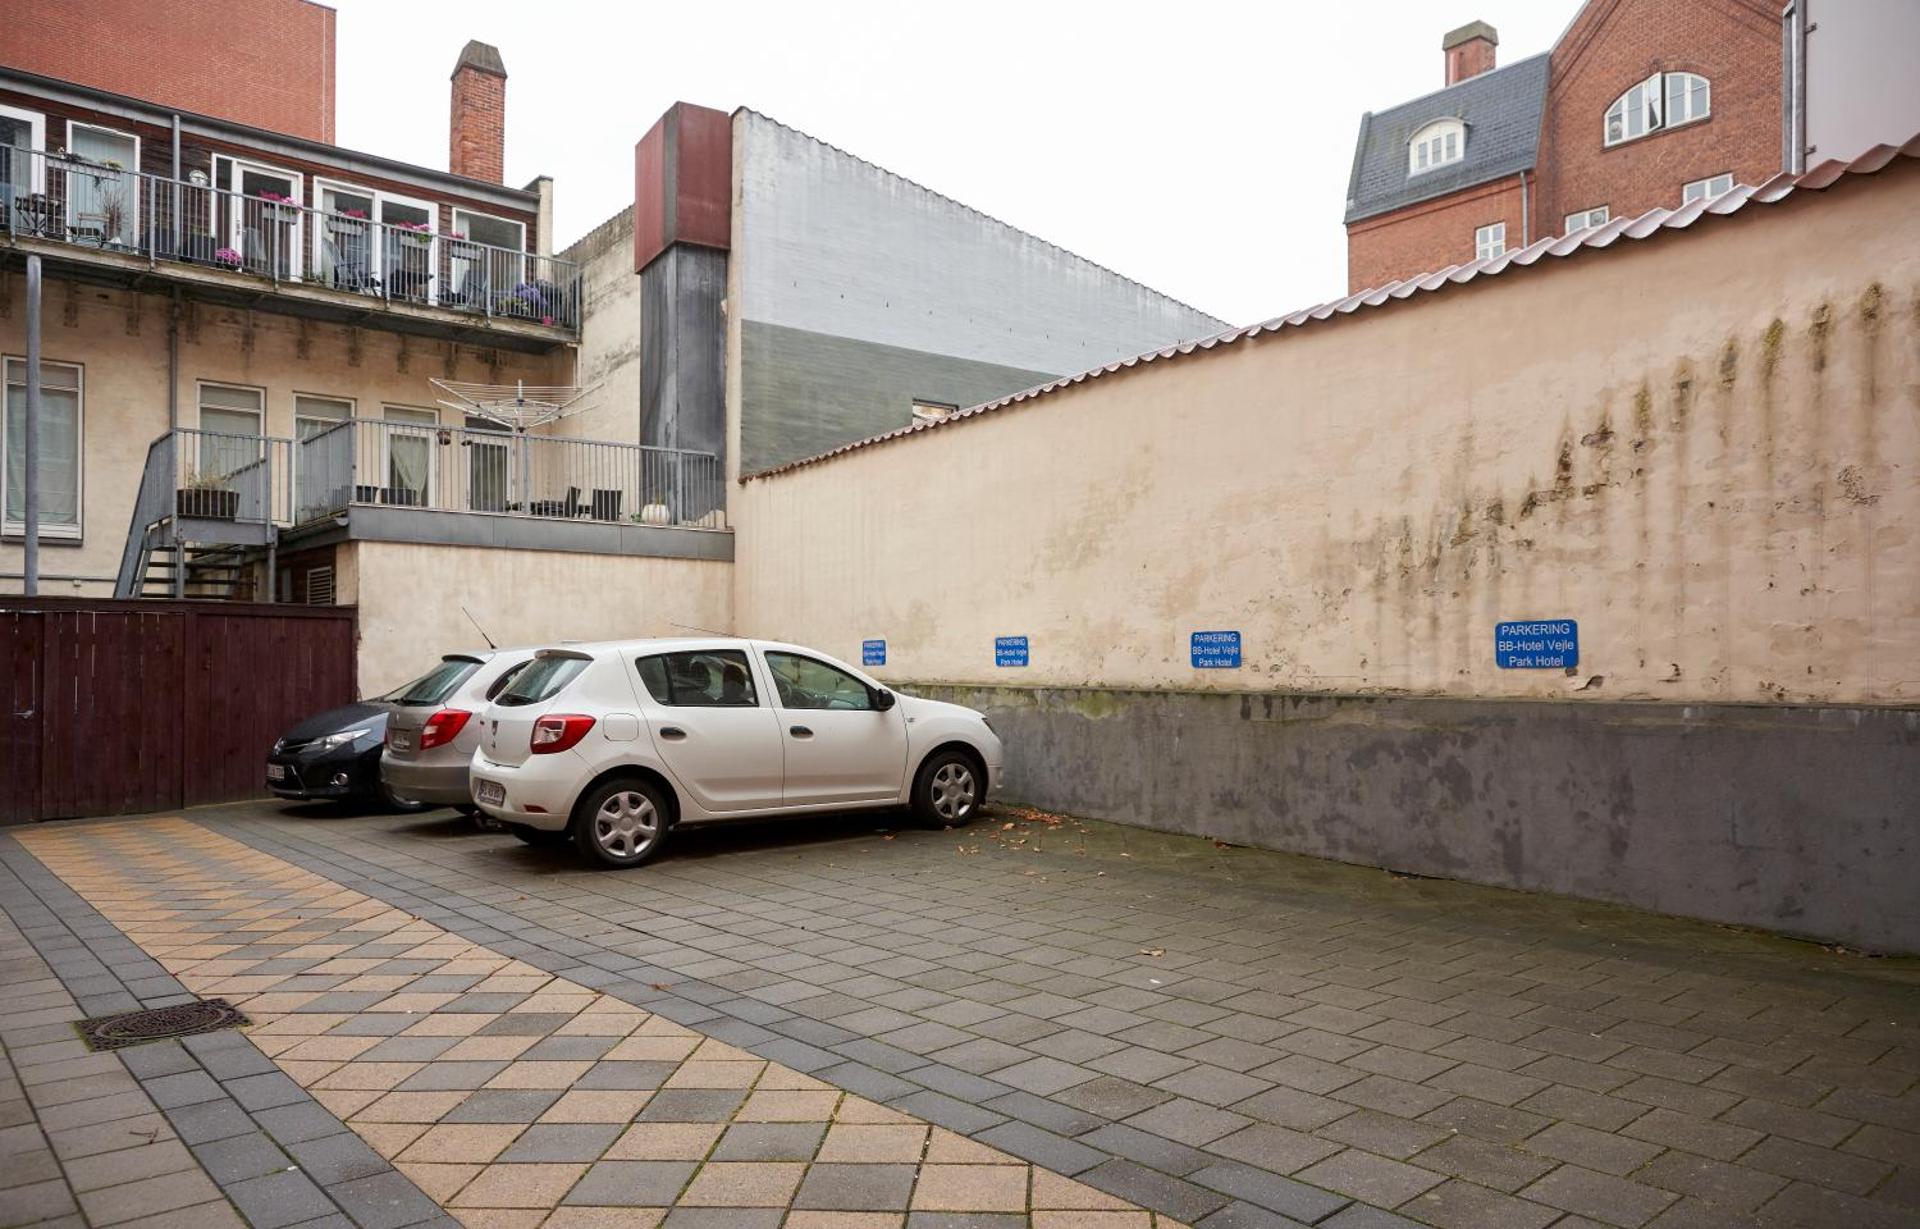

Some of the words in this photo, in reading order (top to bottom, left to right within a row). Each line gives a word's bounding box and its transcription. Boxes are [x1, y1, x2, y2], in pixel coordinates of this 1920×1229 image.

[1502, 623, 1570, 636] PARKERING
[1194, 633, 1237, 642] PARKERING
[1192, 646, 1220, 655] BB-Hotel
[1498, 640, 1545, 651] BB-Hotel
[1547, 639, 1574, 653] Vejle
[1199, 657, 1213, 667] Park
[1215, 657, 1232, 667] Hotel
[1509, 655, 1533, 666] Park
[1536, 655, 1564, 666] Hotel
